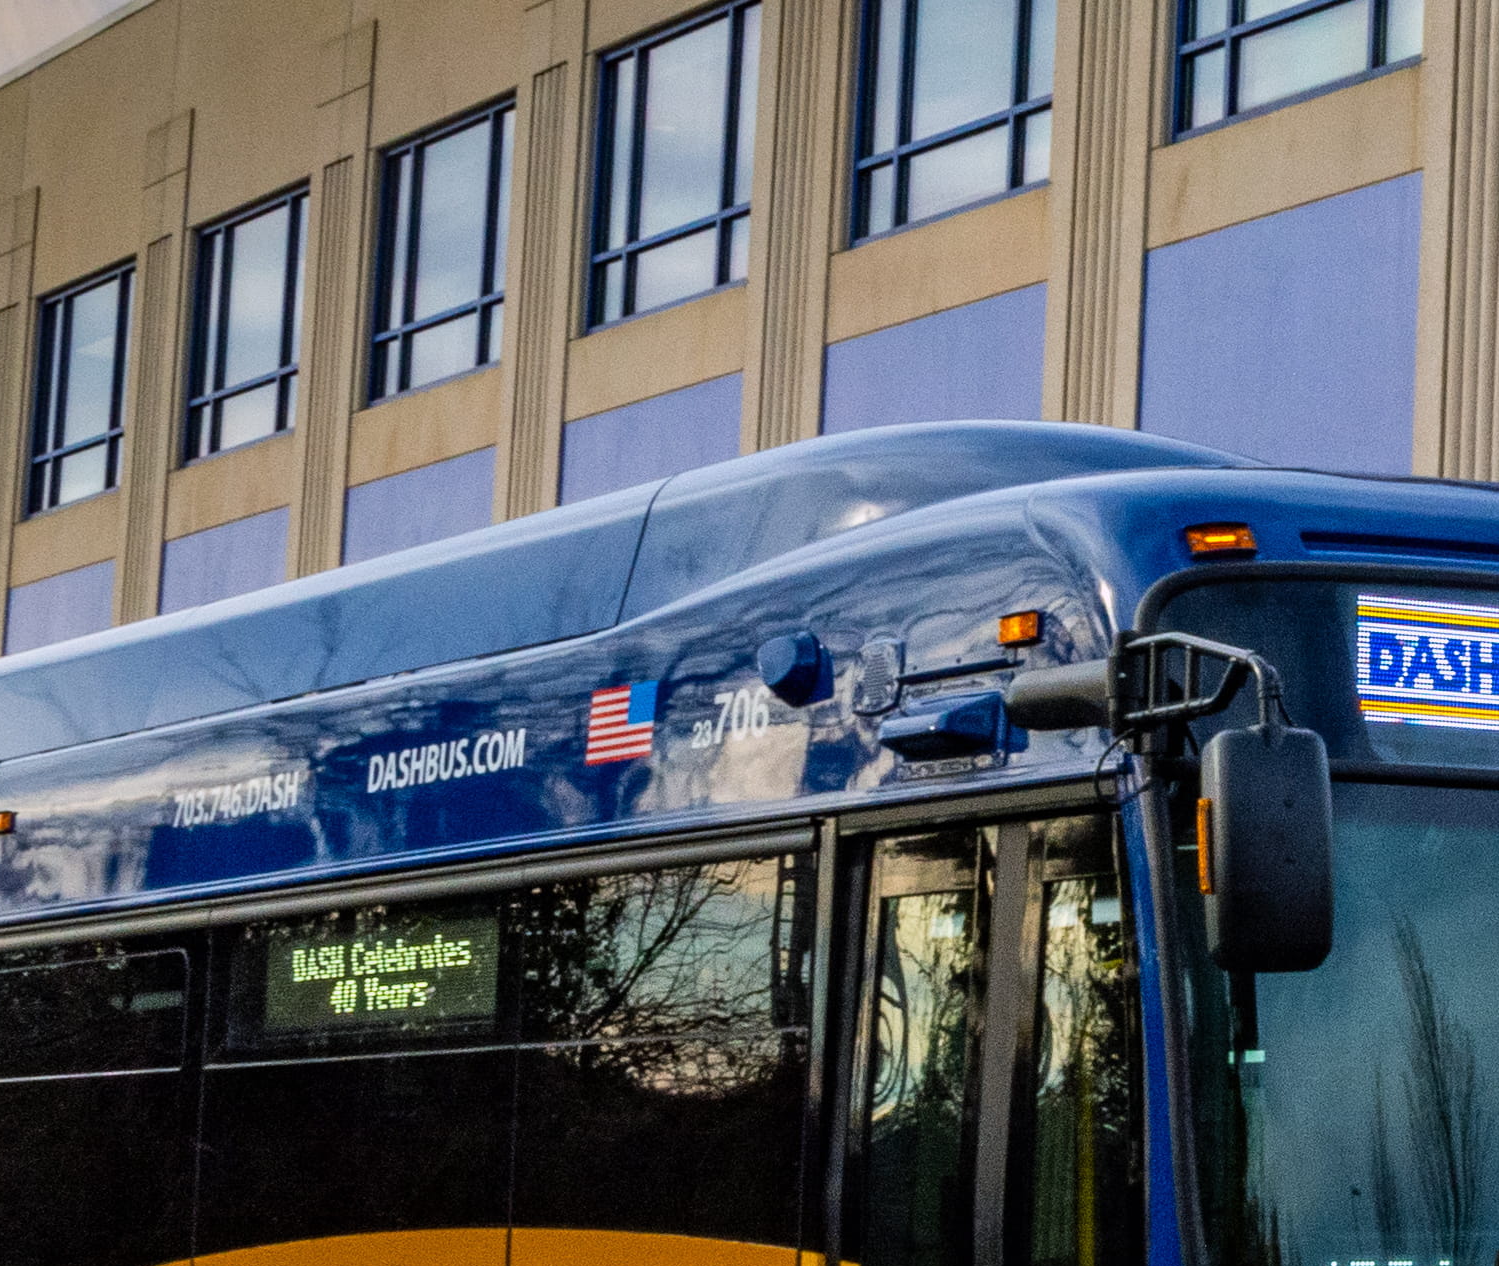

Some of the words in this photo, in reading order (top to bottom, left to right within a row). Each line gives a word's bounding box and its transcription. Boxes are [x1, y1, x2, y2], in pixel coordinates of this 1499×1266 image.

[367, 728, 527, 794] DASHBUS.COM
[172, 771, 300, 829] 703.746.DASH
[292, 944, 345, 982] DASH
[351, 934, 472, 976] Celebrates
[330, 979, 357, 1014] 40
[364, 977, 428, 1011] Years
